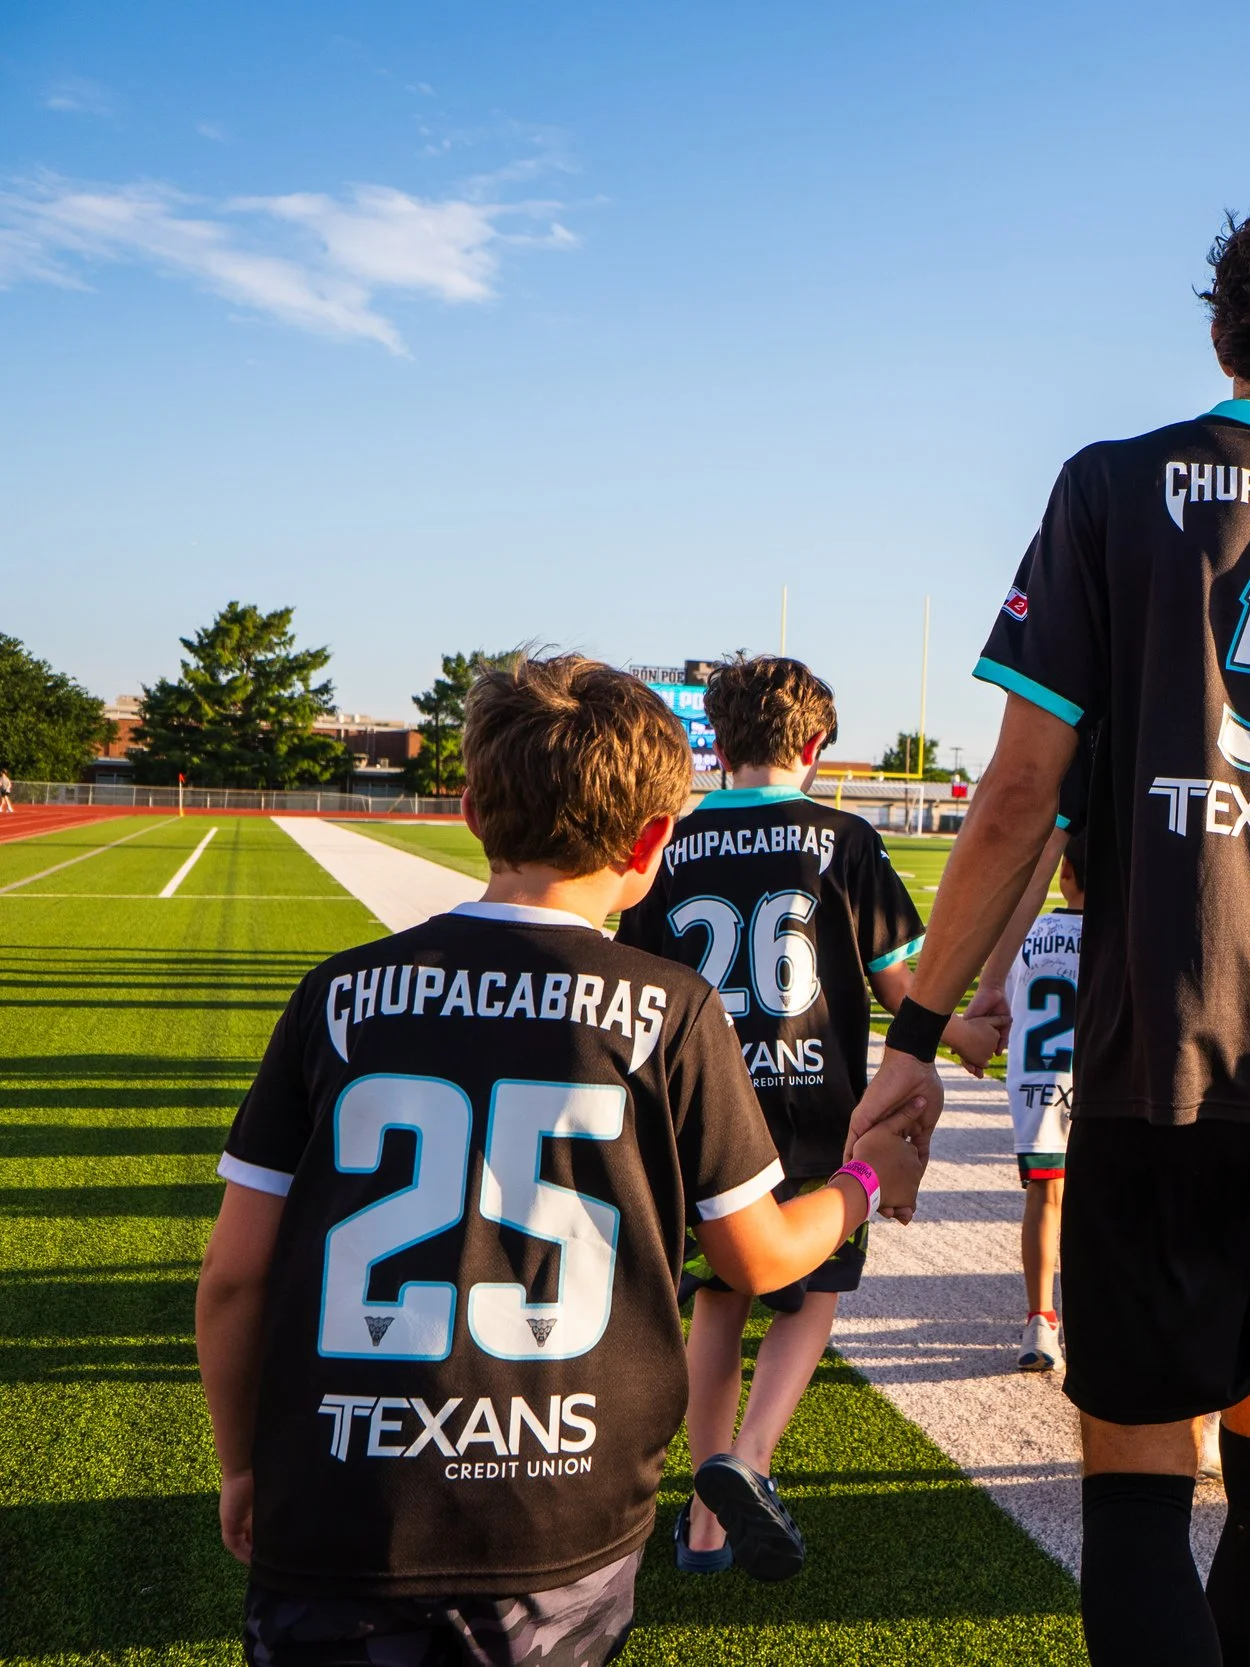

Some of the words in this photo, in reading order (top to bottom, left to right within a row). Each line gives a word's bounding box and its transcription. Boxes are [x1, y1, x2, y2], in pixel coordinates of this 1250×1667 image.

[664, 825, 835, 876] CHUPACABRAS
[667, 889, 822, 1018] 26
[326, 965, 667, 1075] CHUPACABRAS
[753, 1076, 785, 1088] REDIT
[788, 1074, 824, 1087] UNION
[1019, 1083, 1073, 1109] TEX
[317, 1073, 627, 1360] 25
[318, 1393, 597, 1462] TEXANS
[445, 1462, 519, 1480] CREDIT
[526, 1456, 593, 1478] UNION
